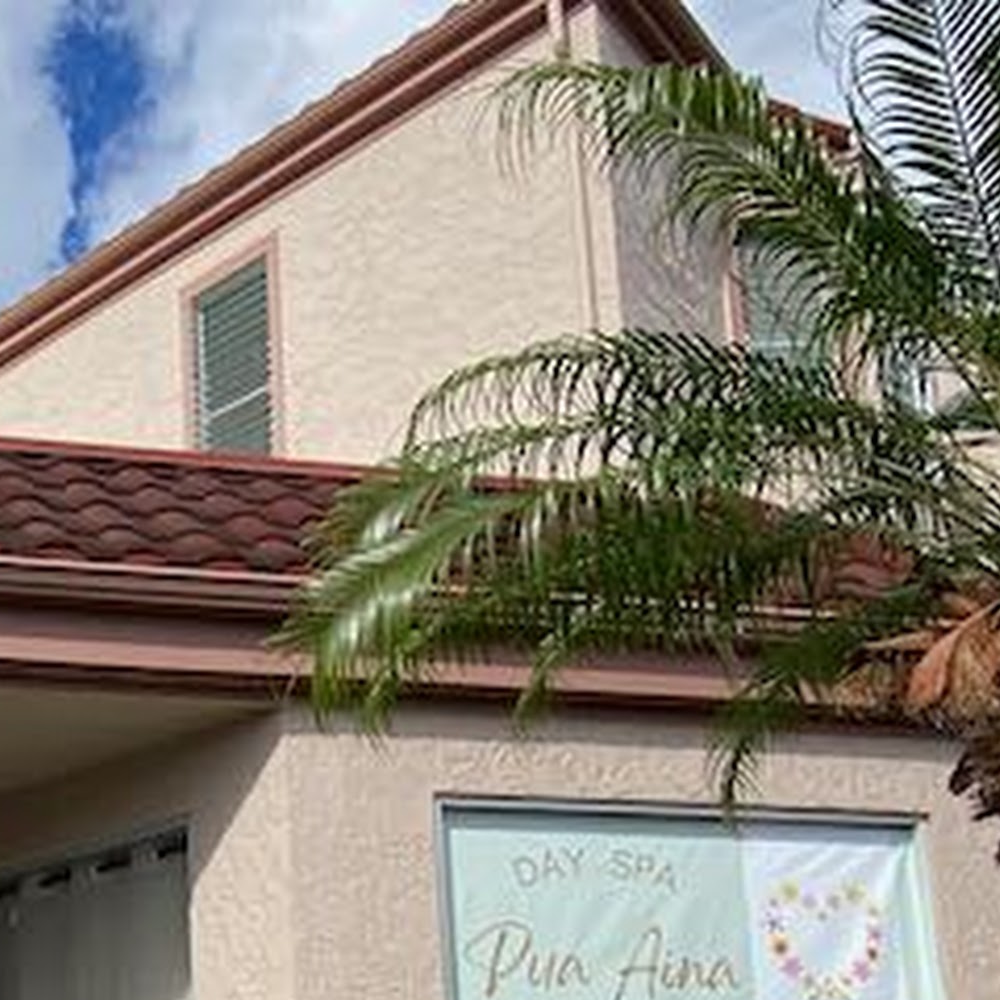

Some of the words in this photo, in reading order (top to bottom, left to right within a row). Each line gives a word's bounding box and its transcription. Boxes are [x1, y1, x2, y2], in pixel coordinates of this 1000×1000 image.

[512, 848, 586, 889] DAY
[609, 848, 679, 893] SPA
[465, 920, 590, 997] Pua
